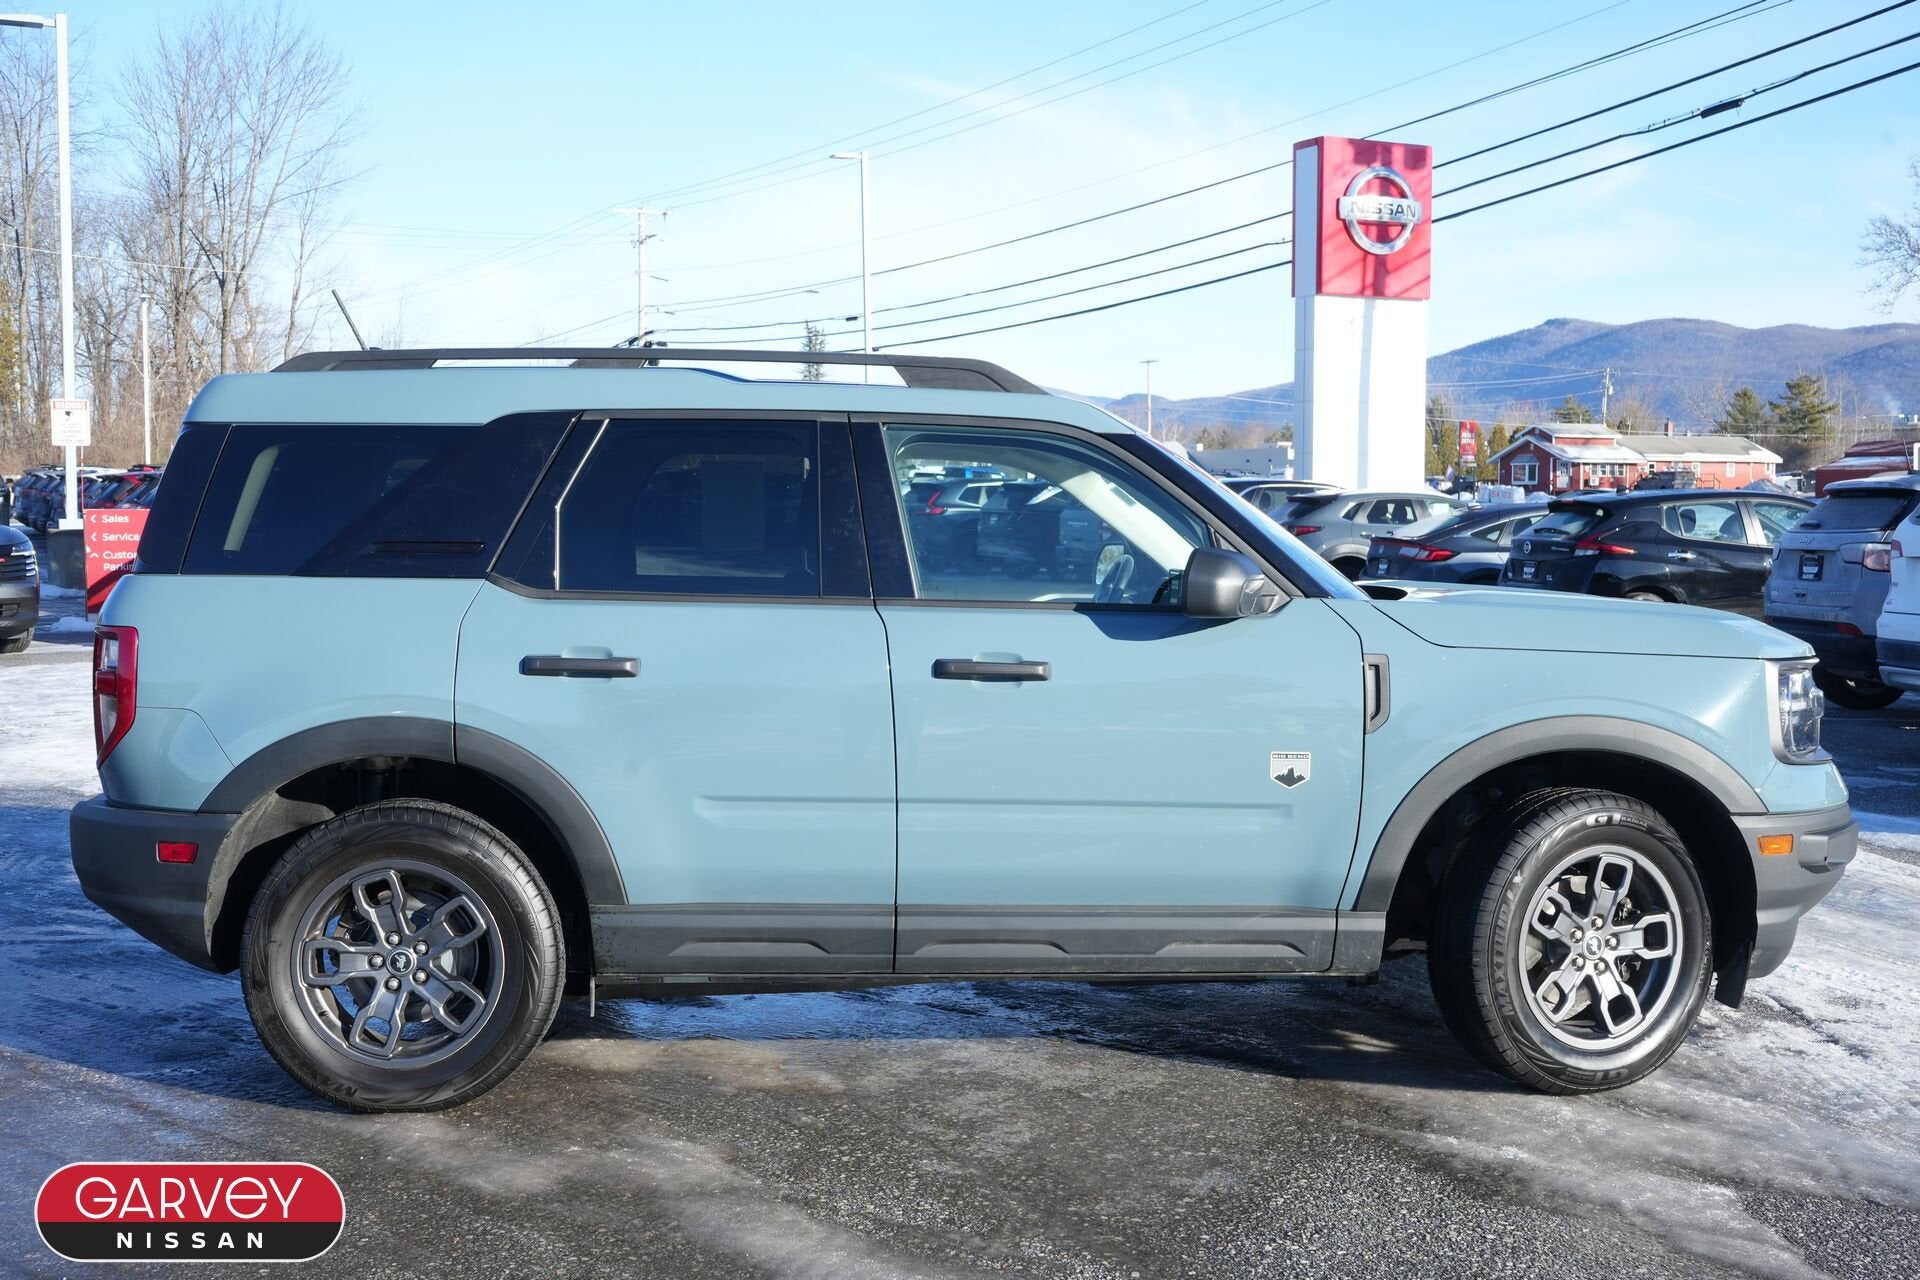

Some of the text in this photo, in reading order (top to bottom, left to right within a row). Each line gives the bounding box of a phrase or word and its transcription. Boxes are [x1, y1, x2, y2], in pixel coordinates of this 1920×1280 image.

[1350, 201, 1416, 218] NISSAN
[102, 515, 129, 523] Sales
[102, 533, 140, 541] Service
